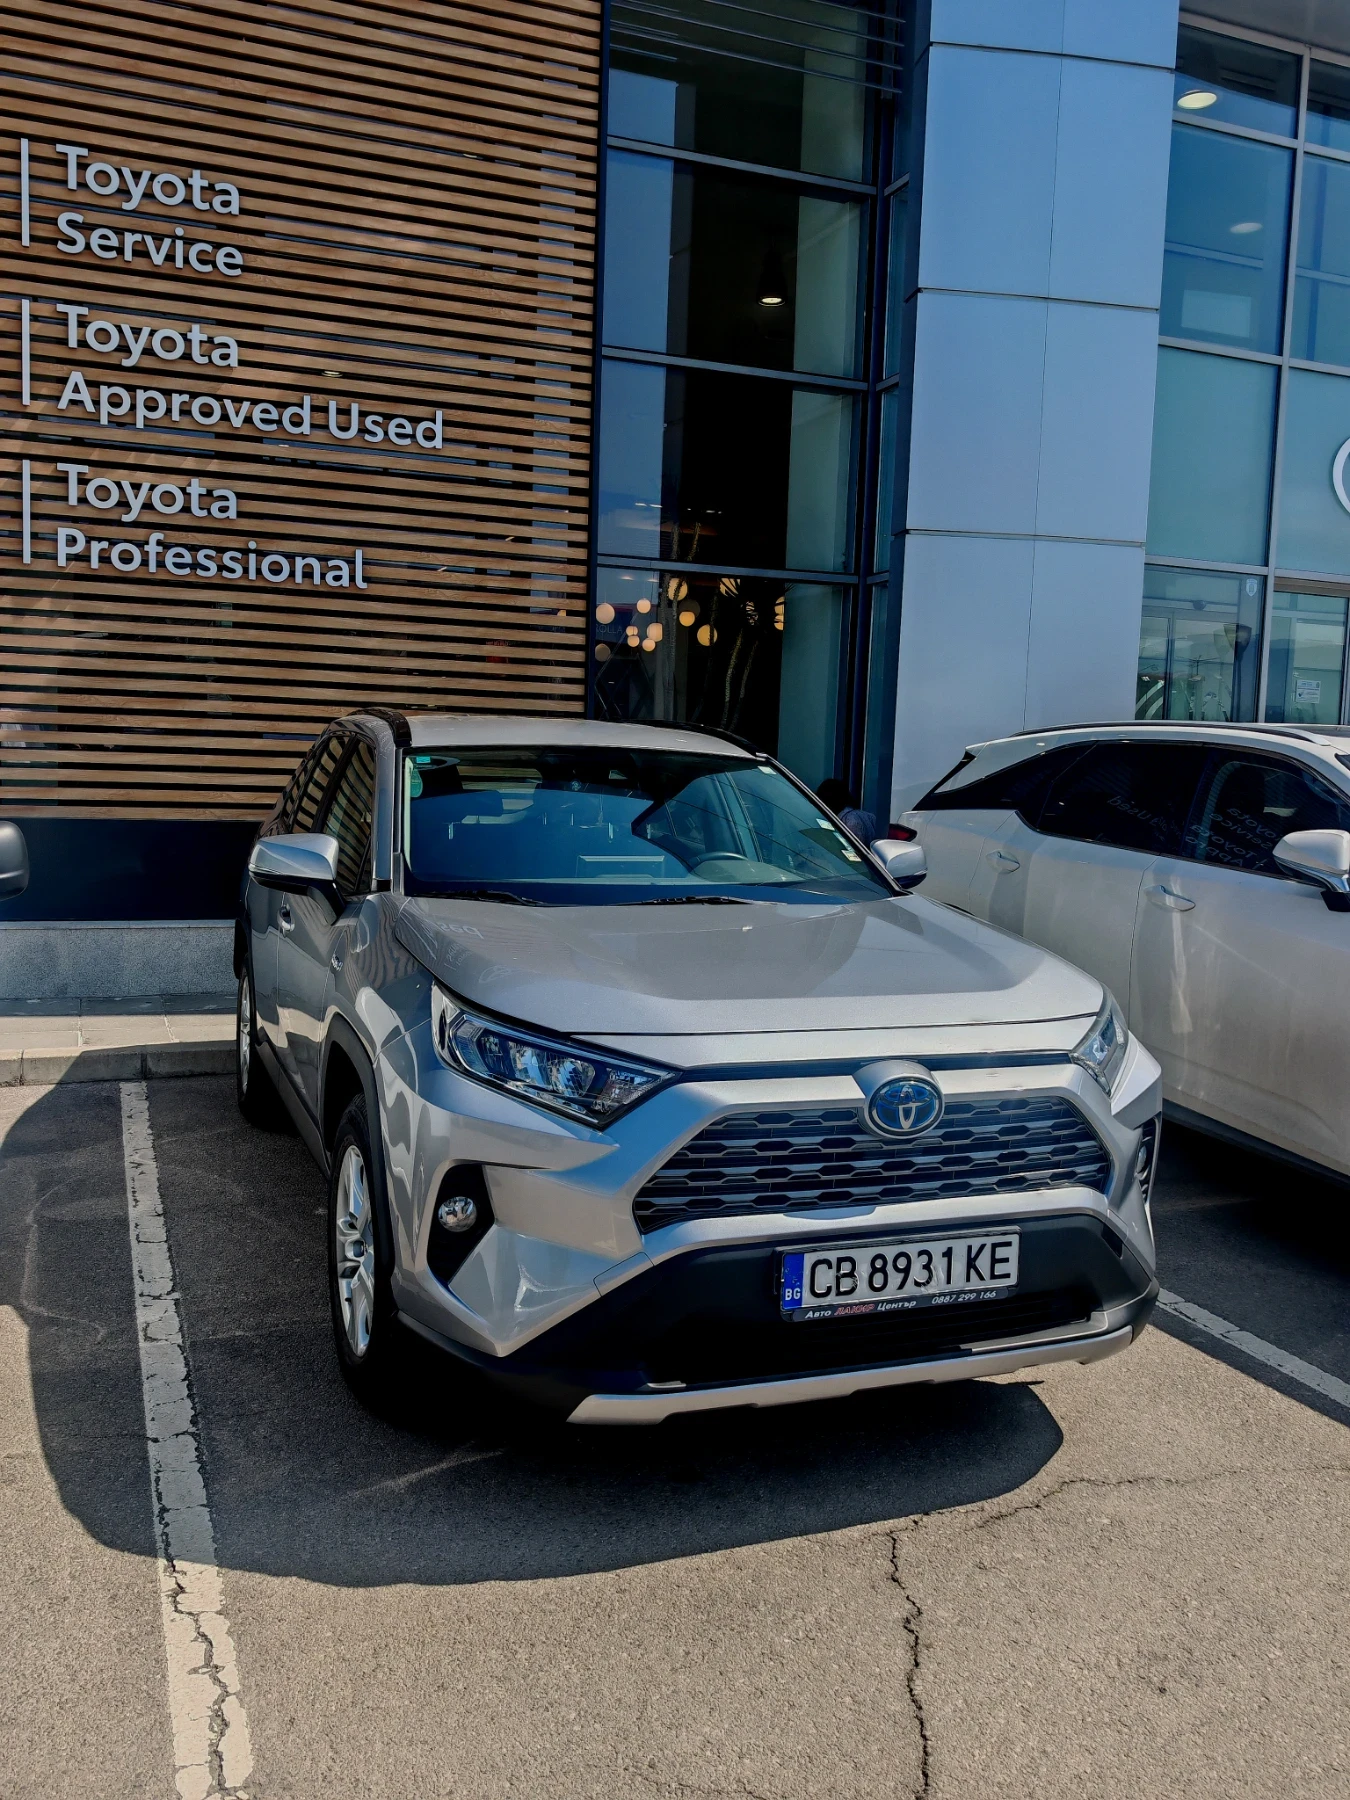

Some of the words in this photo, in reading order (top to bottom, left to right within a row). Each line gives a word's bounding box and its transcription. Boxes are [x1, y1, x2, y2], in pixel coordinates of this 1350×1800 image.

[55, 143, 241, 216] Toyota
[56, 212, 245, 277] Service
[55, 303, 240, 368] Toyota
[57, 371, 312, 436] Approved
[327, 400, 444, 450] Used
[56, 462, 239, 523] Toyota
[57, 526, 369, 589] Professional
[784, 1287, 802, 1301] BG
[804, 1308, 832, 1319] Авто
[876, 1299, 917, 1312] Център
[931, 1294, 956, 1305] 0887
[957, 1291, 978, 1302] 299
[978, 1289, 998, 1300] 166
